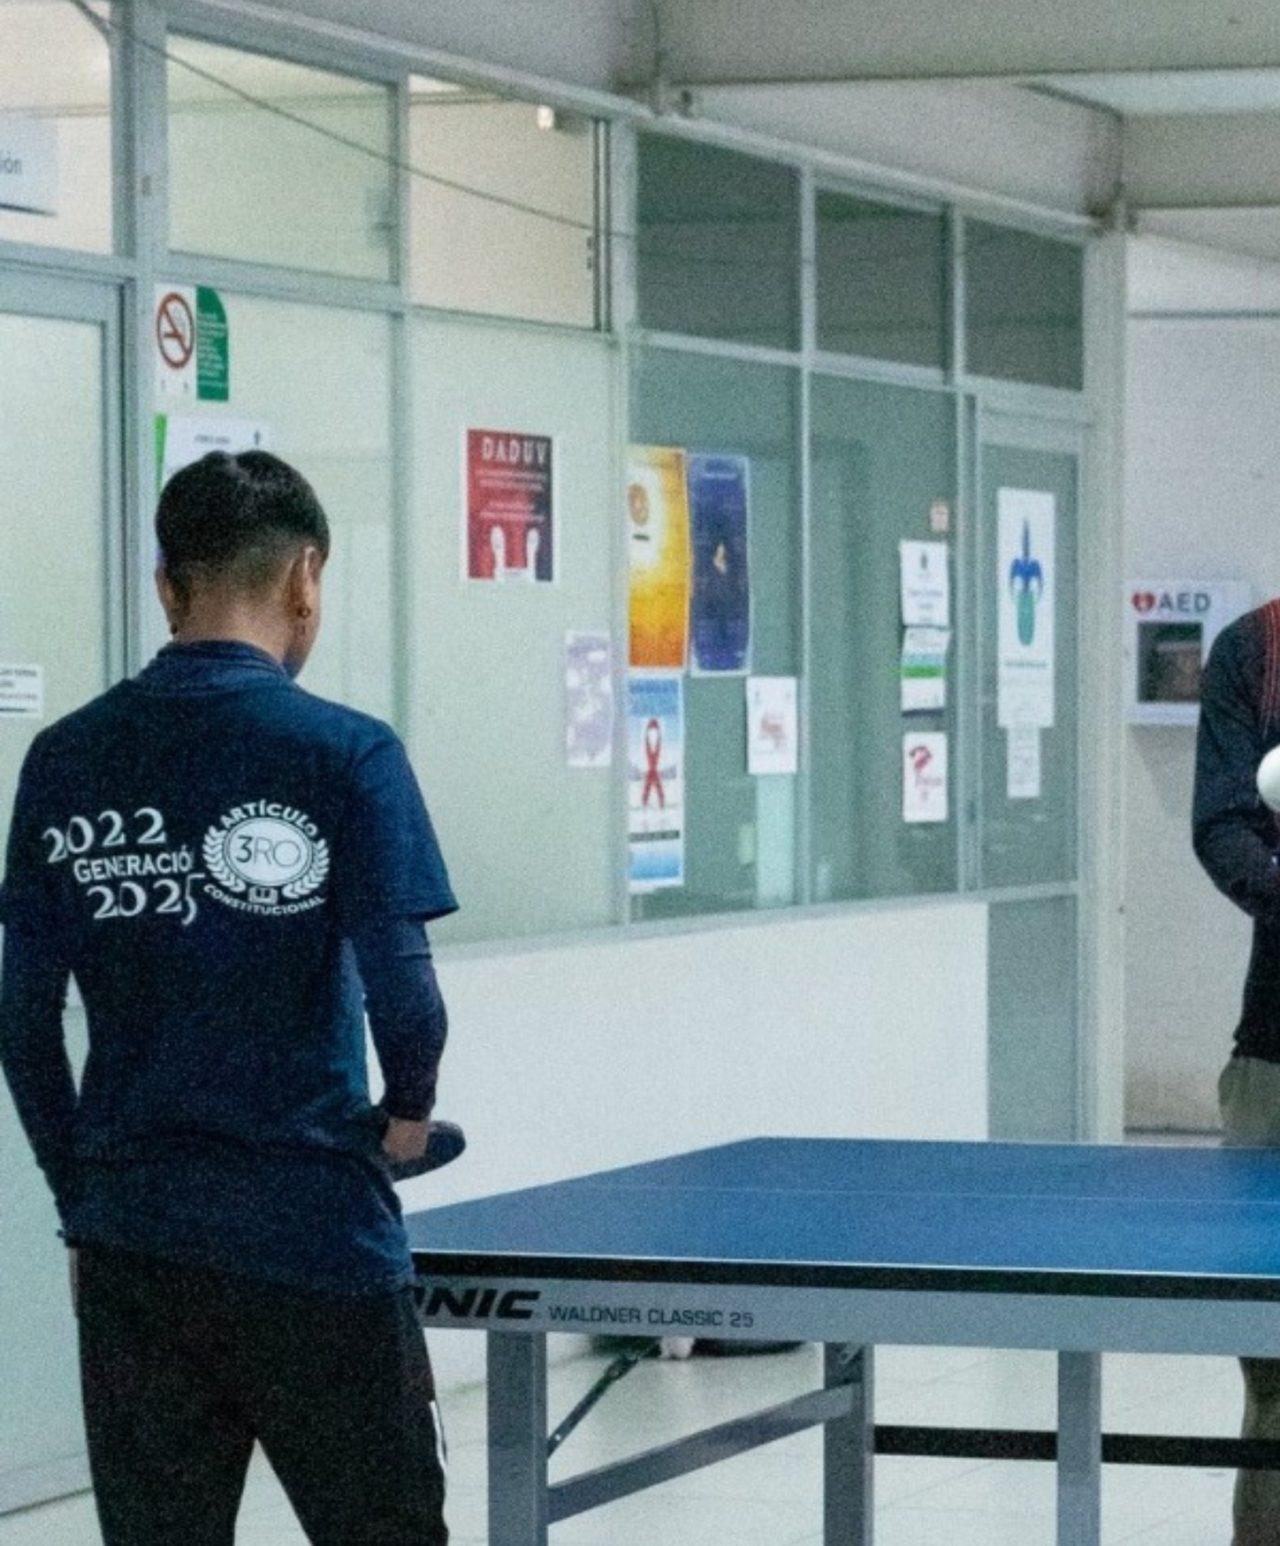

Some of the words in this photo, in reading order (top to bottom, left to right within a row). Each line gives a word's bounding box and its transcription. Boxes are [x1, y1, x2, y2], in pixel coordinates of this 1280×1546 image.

[481, 435, 548, 464] DADUV
[1159, 591, 1211, 613] AED
[220, 798, 318, 837] ARTÍCULO
[41, 806, 167, 863] 2022
[236, 834, 302, 867] 3RO
[73, 844, 196, 883] GENERACIÓ
[87, 870, 205, 926] 2025
[203, 883, 327, 916] CONSTITUCIONAL
[548, 1305, 641, 1324] WALDNER
[647, 1308, 724, 1327] CLASSIC
[729, 1311, 755, 1329] 25
